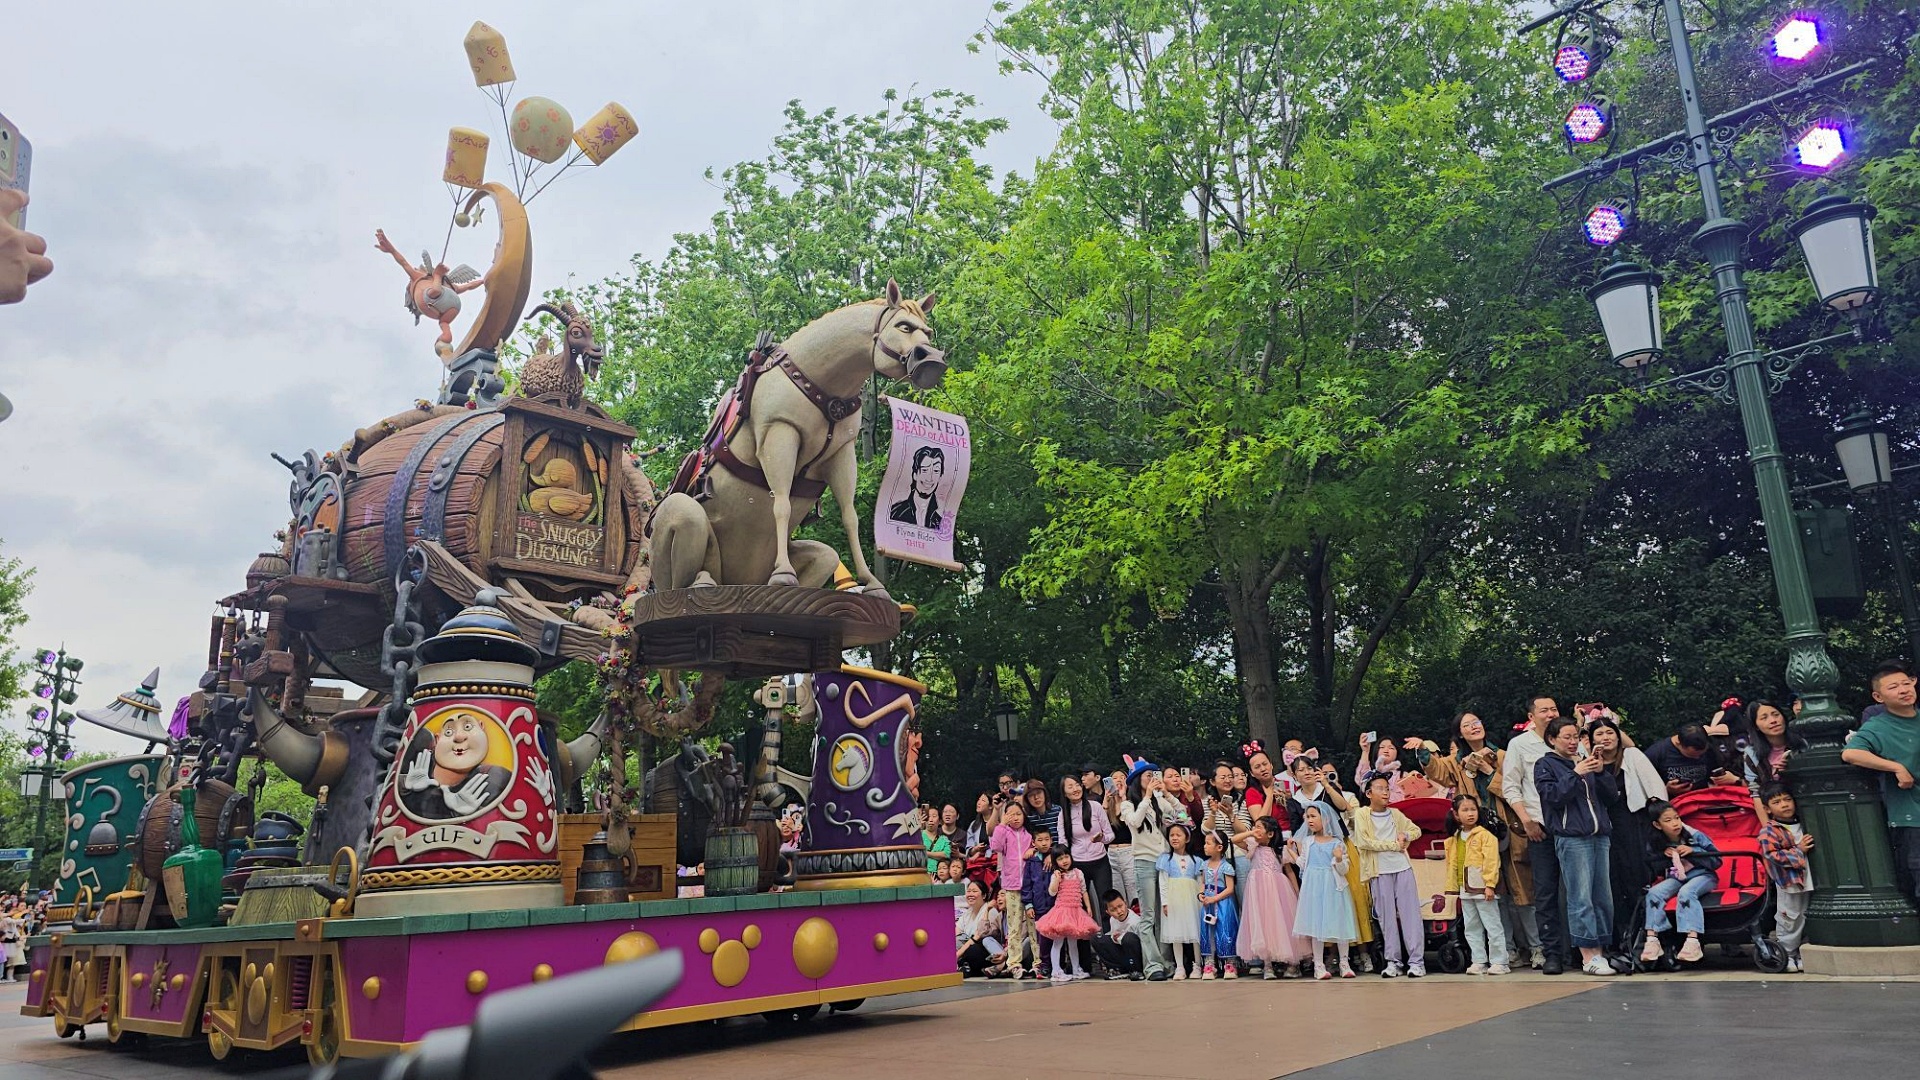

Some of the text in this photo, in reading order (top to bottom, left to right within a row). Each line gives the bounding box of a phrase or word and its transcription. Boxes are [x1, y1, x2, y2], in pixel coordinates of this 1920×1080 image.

[896, 419, 926, 438] DEAD
[938, 433, 968, 449] ALIVE
[898, 408, 965, 436] WANTED
[517, 516, 603, 550] The SNUGGLY
[515, 533, 587, 566] DUCKLING
[421, 827, 466, 845] ULF
